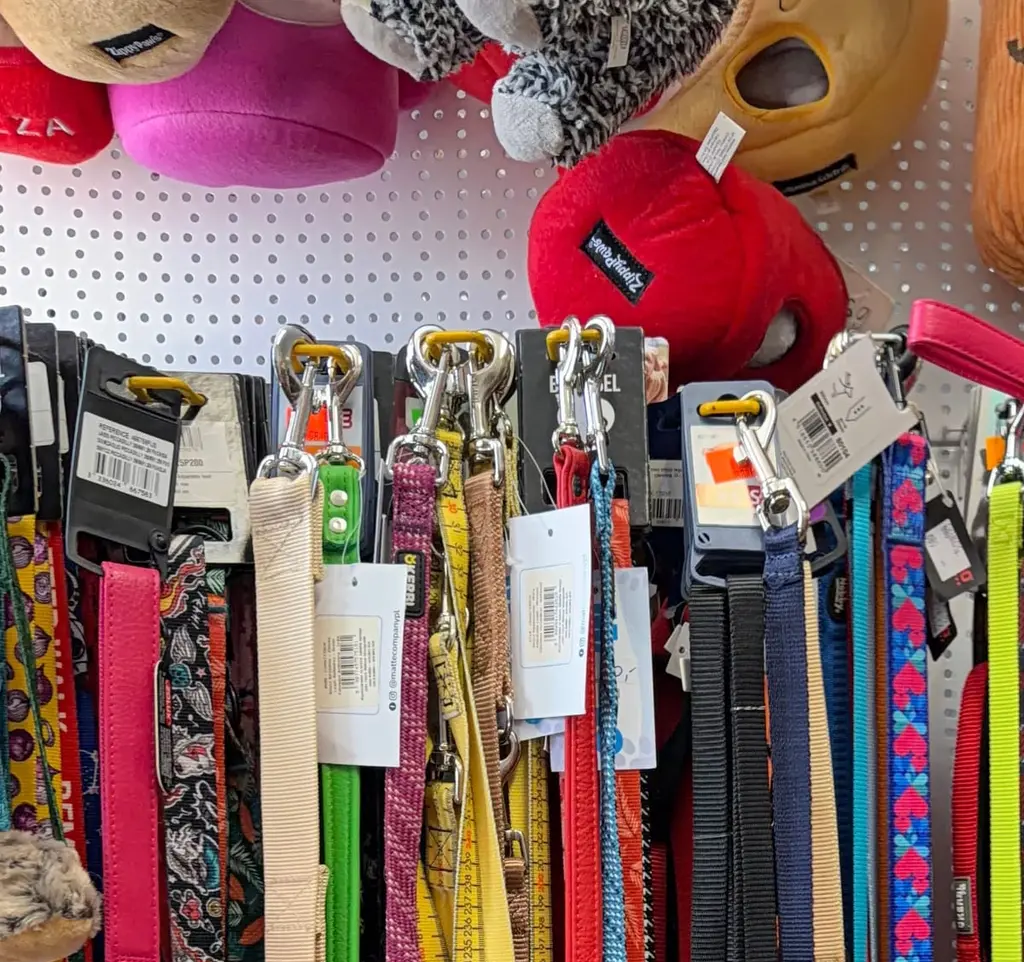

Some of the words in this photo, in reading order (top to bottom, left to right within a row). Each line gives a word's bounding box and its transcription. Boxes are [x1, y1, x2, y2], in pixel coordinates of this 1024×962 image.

[464, 896, 473, 916] 237
[463, 917, 473, 937] 236
[463, 939, 473, 959] 235
